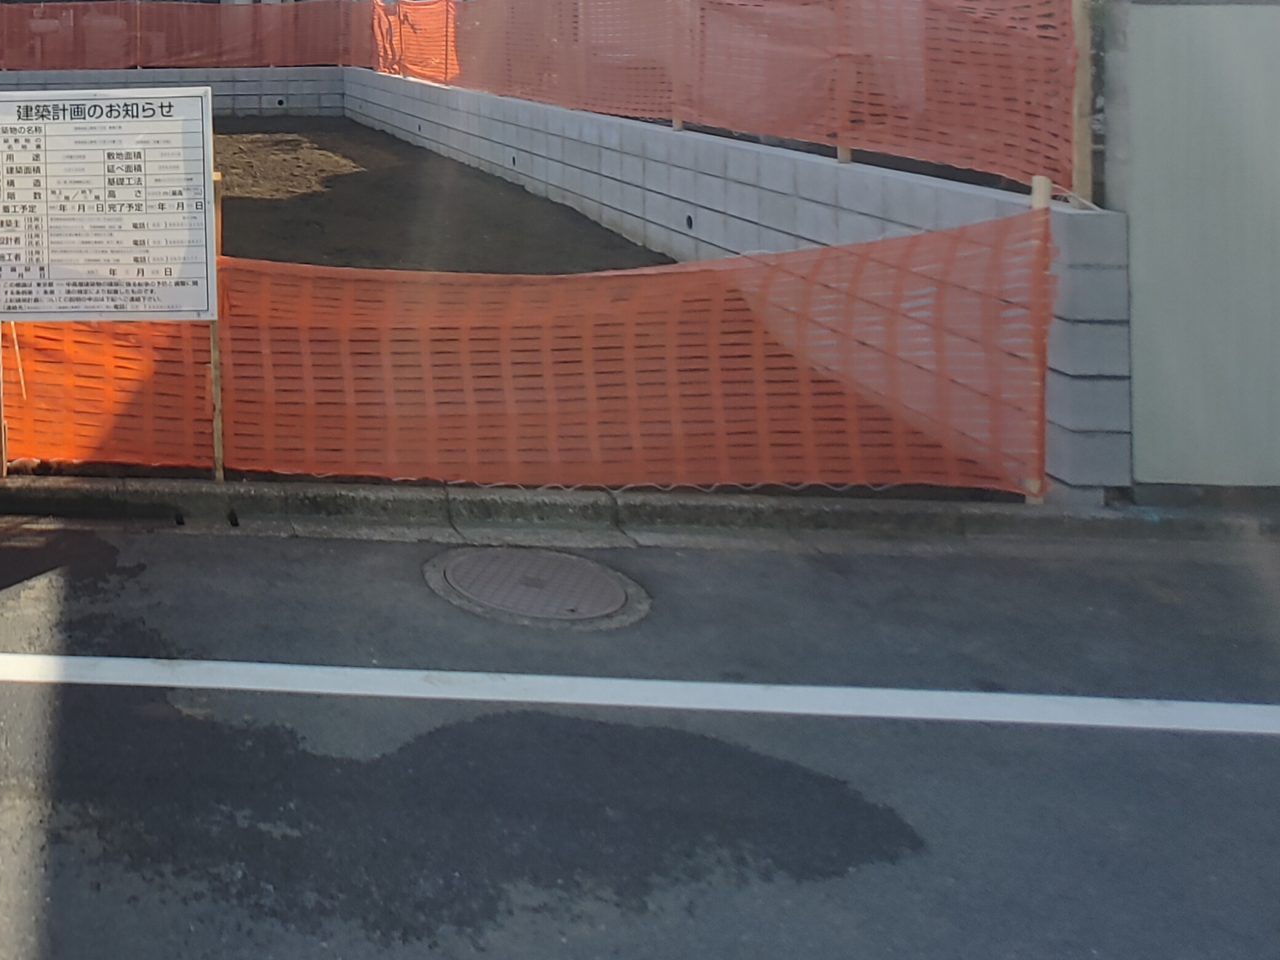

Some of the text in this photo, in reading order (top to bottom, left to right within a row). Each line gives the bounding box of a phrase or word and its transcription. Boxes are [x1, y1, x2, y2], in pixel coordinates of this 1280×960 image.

[16, 102, 174, 121] 建築計画のお知らせ
[107, 151, 142, 160] 敷地面積
[6, 166, 41, 175] 建築面積
[107, 164, 142, 173] 延べ面積
[107, 177, 143, 186] 基礎工法
[108, 202, 144, 212] 完了予定
